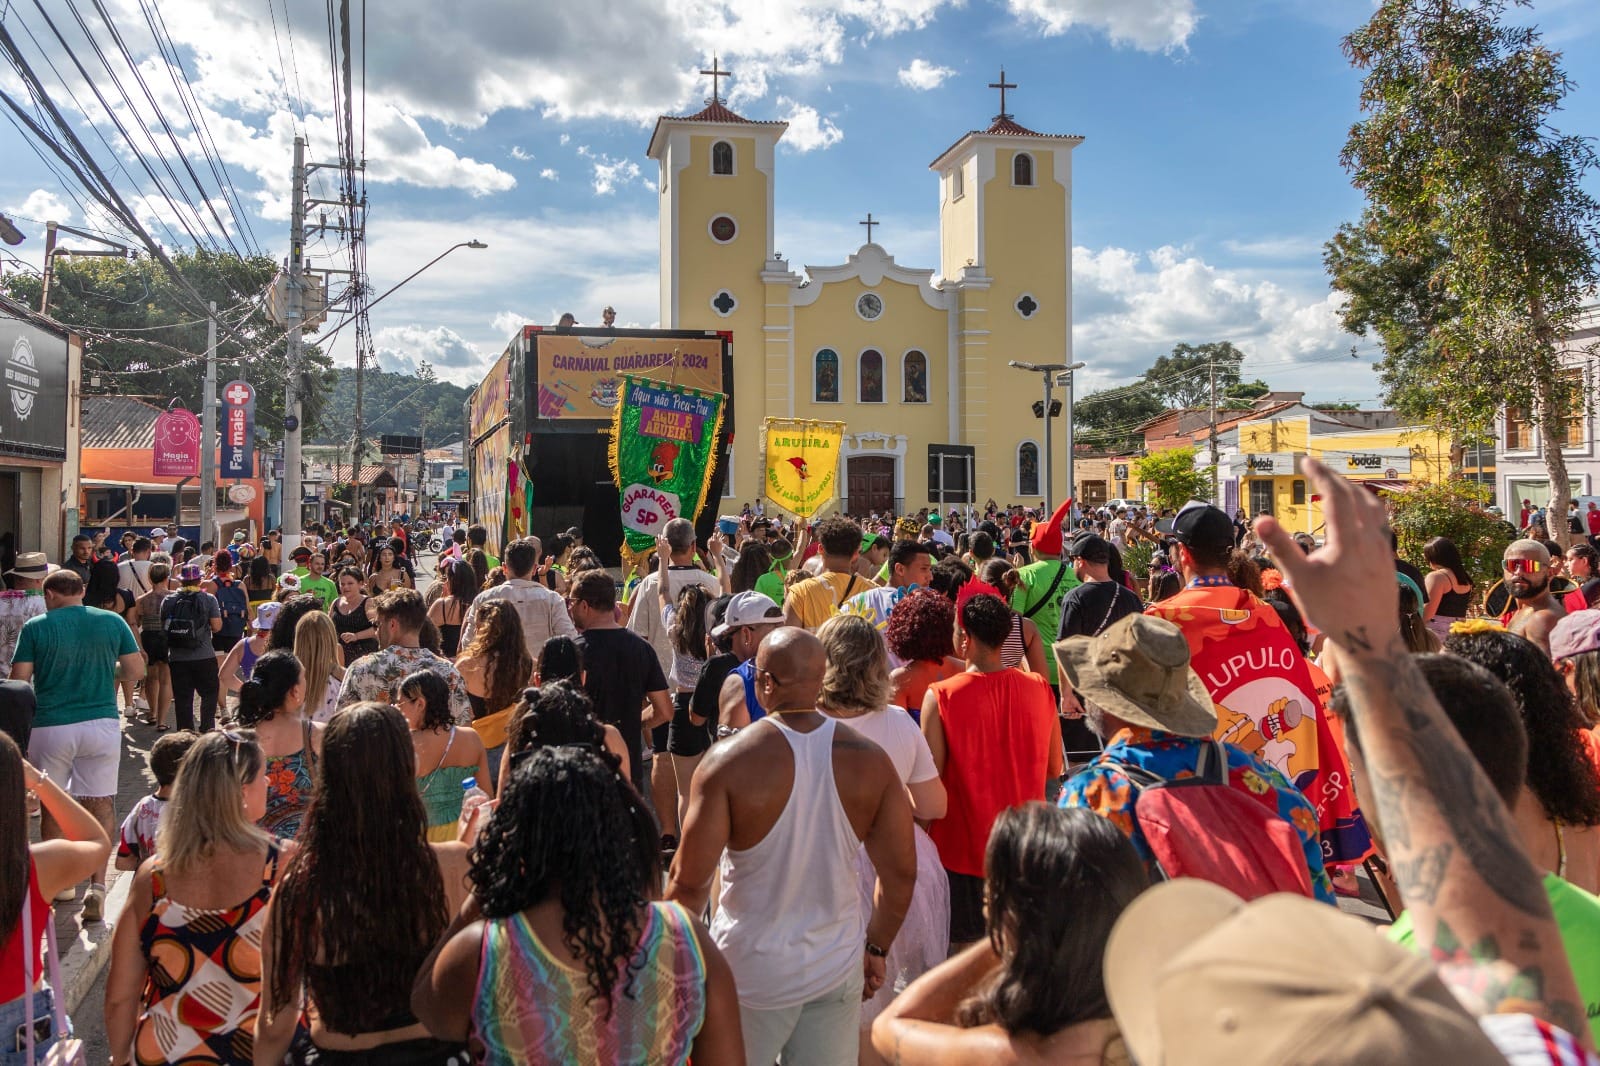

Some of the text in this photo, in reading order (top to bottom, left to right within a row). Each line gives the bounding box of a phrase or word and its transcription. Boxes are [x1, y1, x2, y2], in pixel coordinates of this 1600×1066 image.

[553, 354, 611, 372] CARNAVAL
[682, 353, 709, 370] 2024
[631, 386, 651, 407] Aqui
[654, 393, 670, 407] não
[672, 393, 709, 416] Pica-Pau
[651, 409, 680, 426] AQUI
[229, 409, 244, 471] Farmais
[644, 420, 694, 443] ARUEIRA
[163, 451, 189, 460] Magia
[635, 508, 659, 526] SP
